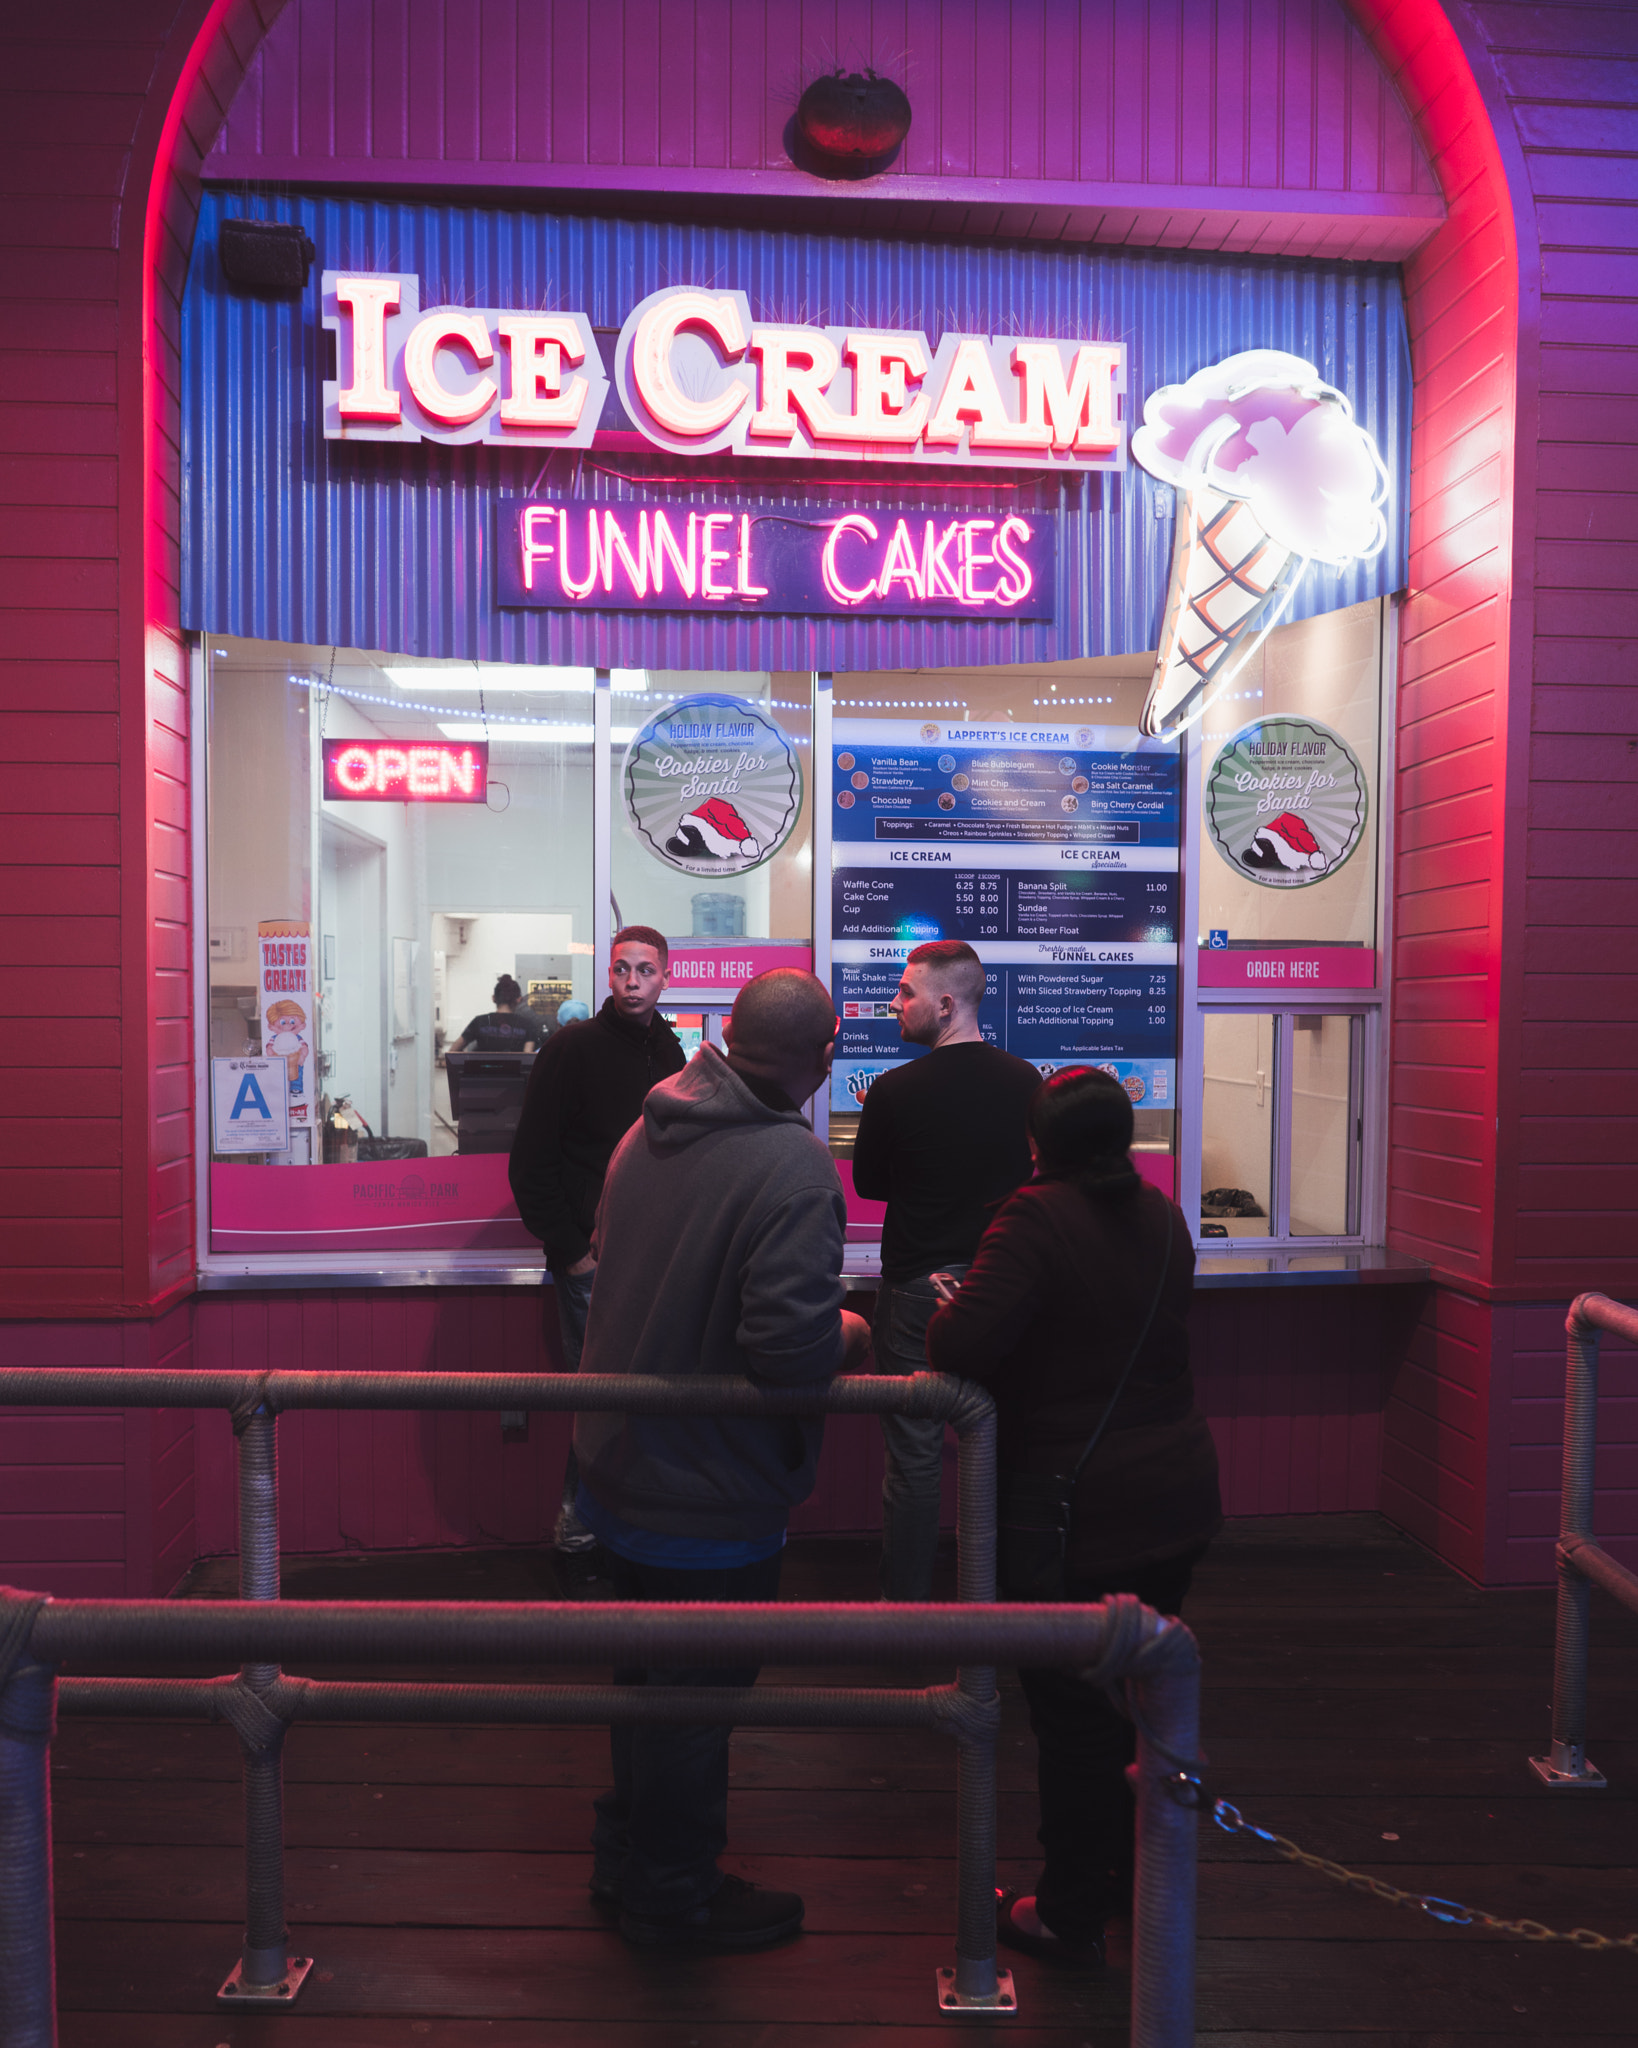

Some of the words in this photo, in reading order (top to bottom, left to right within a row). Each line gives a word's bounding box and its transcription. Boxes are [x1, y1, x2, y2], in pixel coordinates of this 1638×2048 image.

[336, 278, 588, 429] ICE
[632, 290, 1122, 453] CREAM
[522, 506, 768, 599] FUNNEL
[822, 514, 1032, 606] CAKES
[670, 723, 712, 739] HOLIDAY
[716, 722, 754, 738] FLAVOR
[948, 730, 1006, 741] LAPPERT'S
[1010, 732, 1027, 741] ICE
[1030, 732, 1070, 743] CREAM
[1249, 742, 1287, 756] HOLIDAY
[1291, 742, 1326, 756] FLAVOR
[655, 755, 733, 777] Cookies
[732, 752, 768, 779] for
[871, 758, 897, 766] Vanilla
[972, 760, 989, 768] Blue
[991, 760, 1035, 770] Bubblegum
[1091, 762, 1118, 771] Cookie
[1120, 764, 1151, 772] Monster
[337, 748, 472, 793] OPEN
[872, 777, 914, 786] Strawberry
[991, 780, 1009, 788] Chip
[1106, 782, 1120, 790] Salt
[1122, 782, 1154, 790] Caramel
[1235, 772, 1305, 792] Cookies
[1304, 770, 1337, 795] for
[680, 775, 742, 802] Santa
[871, 796, 912, 804] Chocolate
[1020, 799, 1046, 807] Cream
[1091, 800, 1108, 809] Bing
[1110, 800, 1135, 810] Cherry
[1256, 791, 1312, 816] Santa
[882, 821, 914, 830] Toppings:
[890, 852, 908, 861] ICE
[912, 852, 952, 862] CREAM
[1061, 850, 1078, 859] ICE
[1082, 851, 1120, 860] CREAM
[843, 880, 869, 889] Waffle
[956, 882, 973, 890] 6.25
[980, 882, 997, 890] 8.75
[1018, 882, 1048, 890] Banana
[1050, 882, 1067, 892] Split
[1146, 884, 1167, 892] 11.00
[844, 893, 864, 901] Cake
[956, 894, 974, 902] 5.50
[980, 894, 998, 902] 8.00
[843, 905, 860, 914] Cup
[956, 906, 974, 914] 5.50
[980, 906, 998, 914] 8.00
[1018, 904, 1048, 912] Sundae
[1150, 906, 1166, 914] 7.50
[861, 925, 902, 933] Additional
[905, 926, 938, 935] Topping
[1018, 926, 1037, 934] Root
[262, 944, 306, 966] TASTES
[1052, 952, 1096, 962] FUNNEL
[1099, 952, 1134, 962] CAKES
[672, 961, 715, 979] ORDER
[721, 961, 753, 979] HERE
[1247, 961, 1285, 978] ORDER
[1290, 961, 1320, 978] HERE
[264, 969, 306, 992] GREAT!
[1081, 975, 1103, 984] Sugar
[1064, 987, 1107, 997] Strawberry
[1109, 988, 1142, 997] Topping
[1036, 1006, 1061, 1015] Scoop
[1081, 1017, 1114, 1026] Topping
[230, 1073, 272, 1119] A
[353, 1184, 396, 1198] PACIFIC
[430, 1184, 459, 1197] PARK
